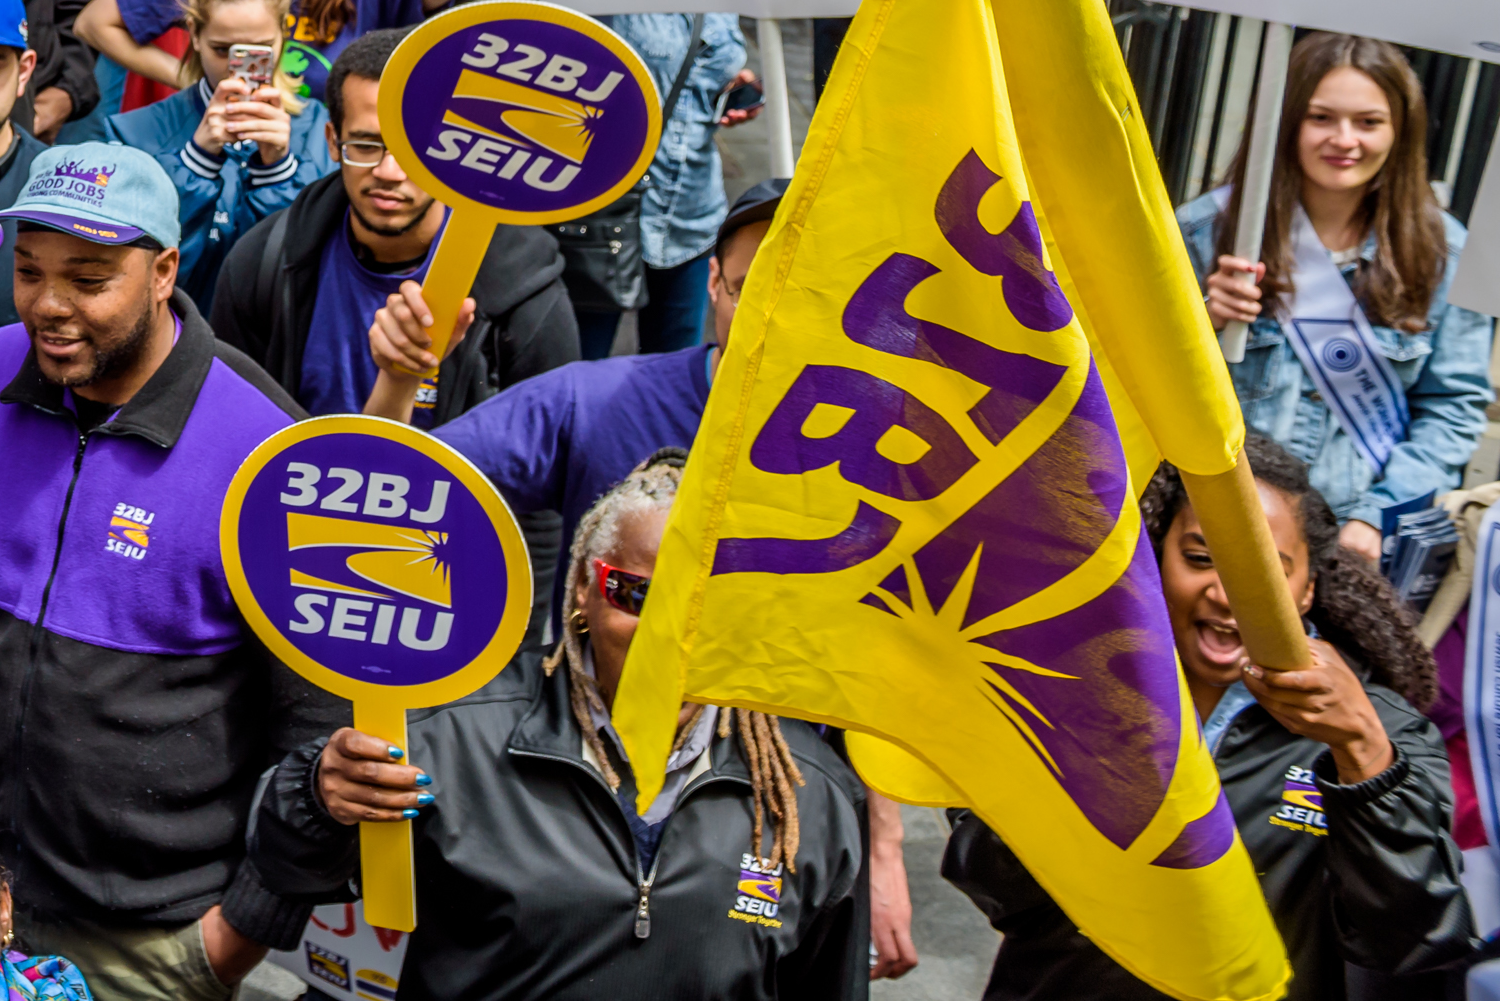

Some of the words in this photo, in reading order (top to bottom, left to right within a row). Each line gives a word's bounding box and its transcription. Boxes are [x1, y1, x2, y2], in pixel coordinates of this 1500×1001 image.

[460, 32, 625, 102] 32BJ
[425, 129, 582, 192] SEIU
[28, 178, 64, 192] GOOD
[66, 180, 106, 200] JOBS
[48, 189, 102, 208] COMMUNITIES
[415, 388, 438, 403] SE
[280, 461, 451, 523] 32BJ
[113, 502, 155, 525] 32BJ
[105, 538, 147, 560] SEIU
[289, 593, 454, 652] SEIU
[734, 895, 779, 918] SEIU
[307, 943, 346, 966] 32BJ
[312, 963, 348, 986] SEIU
